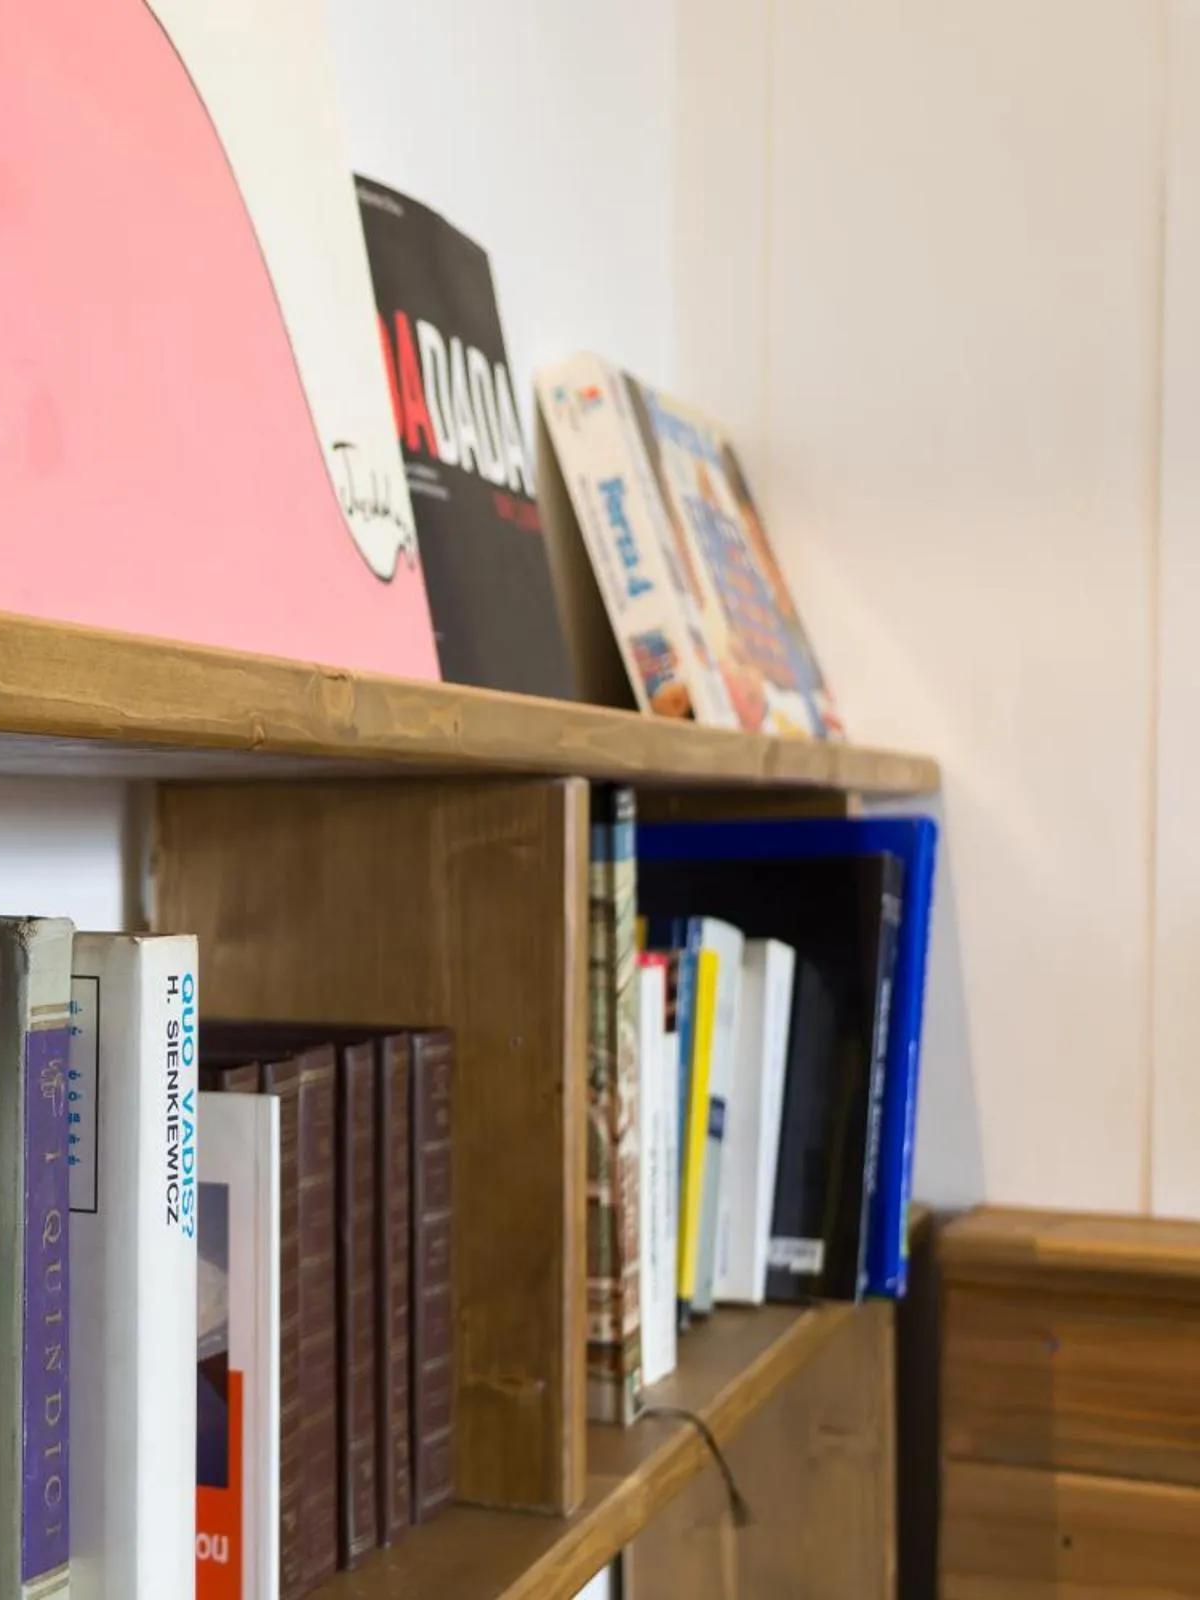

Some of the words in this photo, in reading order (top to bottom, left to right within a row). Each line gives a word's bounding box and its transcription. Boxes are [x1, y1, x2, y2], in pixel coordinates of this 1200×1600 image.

[166, 975, 180, 1004] H.
[181, 972, 195, 1067] QUO
[166, 1019, 180, 1226] SIENKIEWICZ
[181, 1087, 196, 1239] VADIS?
[43, 1208, 63, 1536] QUINDICI
